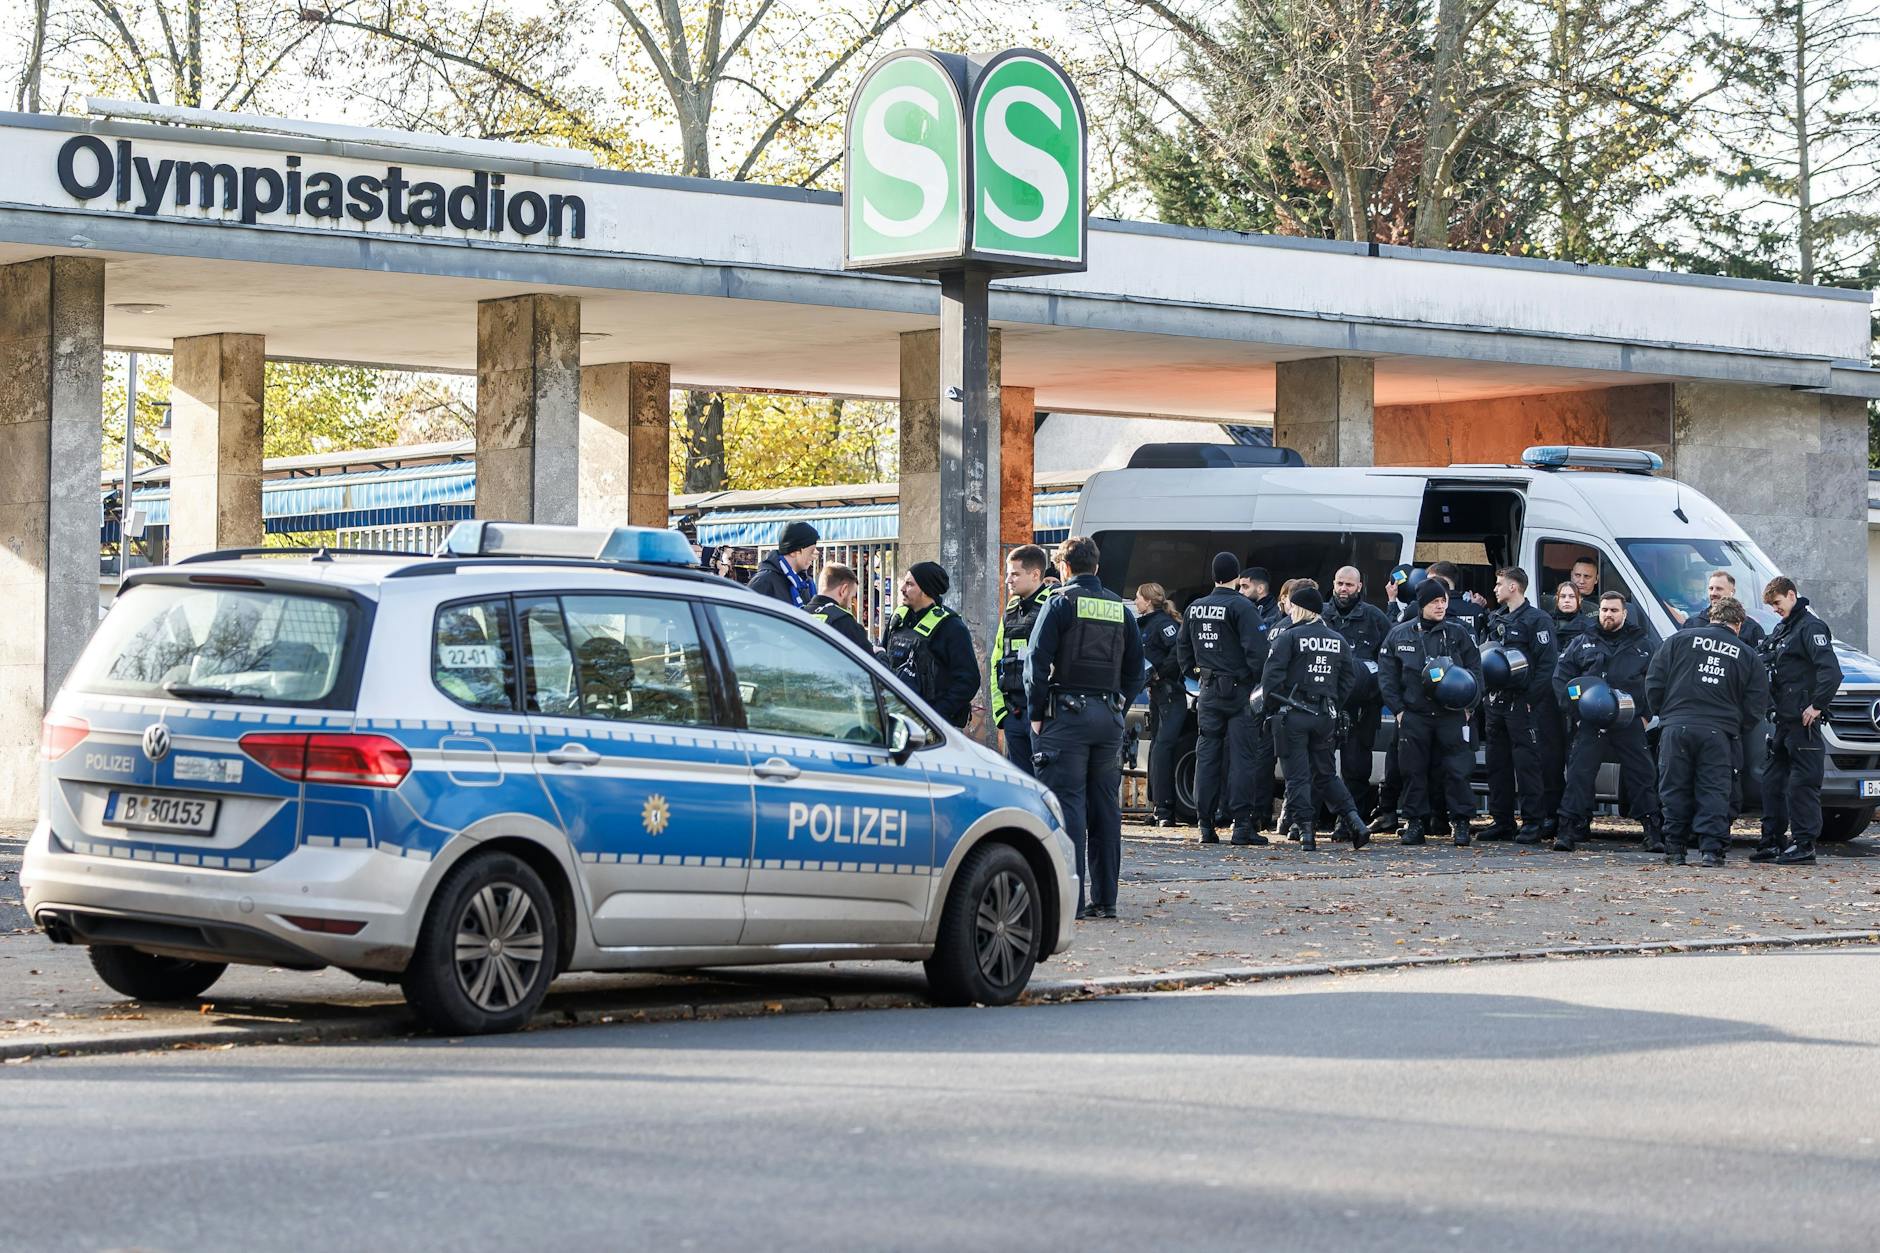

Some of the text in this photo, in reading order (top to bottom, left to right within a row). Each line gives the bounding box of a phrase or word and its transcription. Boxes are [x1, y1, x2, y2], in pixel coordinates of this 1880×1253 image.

[862, 85, 1070, 238] S S
[57, 134, 587, 240] Olympiastadion
[1080, 600, 1123, 620] POLIZEI
[1189, 605, 1226, 620] POLIZEI
[1202, 622, 1212, 632] BE
[1198, 632, 1219, 641] 14120
[1299, 637, 1341, 653] POLIZEI
[1692, 636, 1740, 659] POLIZEI
[448, 649, 488, 664] 22-01
[1315, 655, 1327, 665] BE
[1707, 655, 1721, 666] BE
[1308, 664, 1332, 674] 14112
[1698, 663, 1726, 677] 14101
[85, 753, 136, 774] POLIZEI
[125, 796, 205, 826] B 30153
[787, 801, 907, 847] POLIZEI
